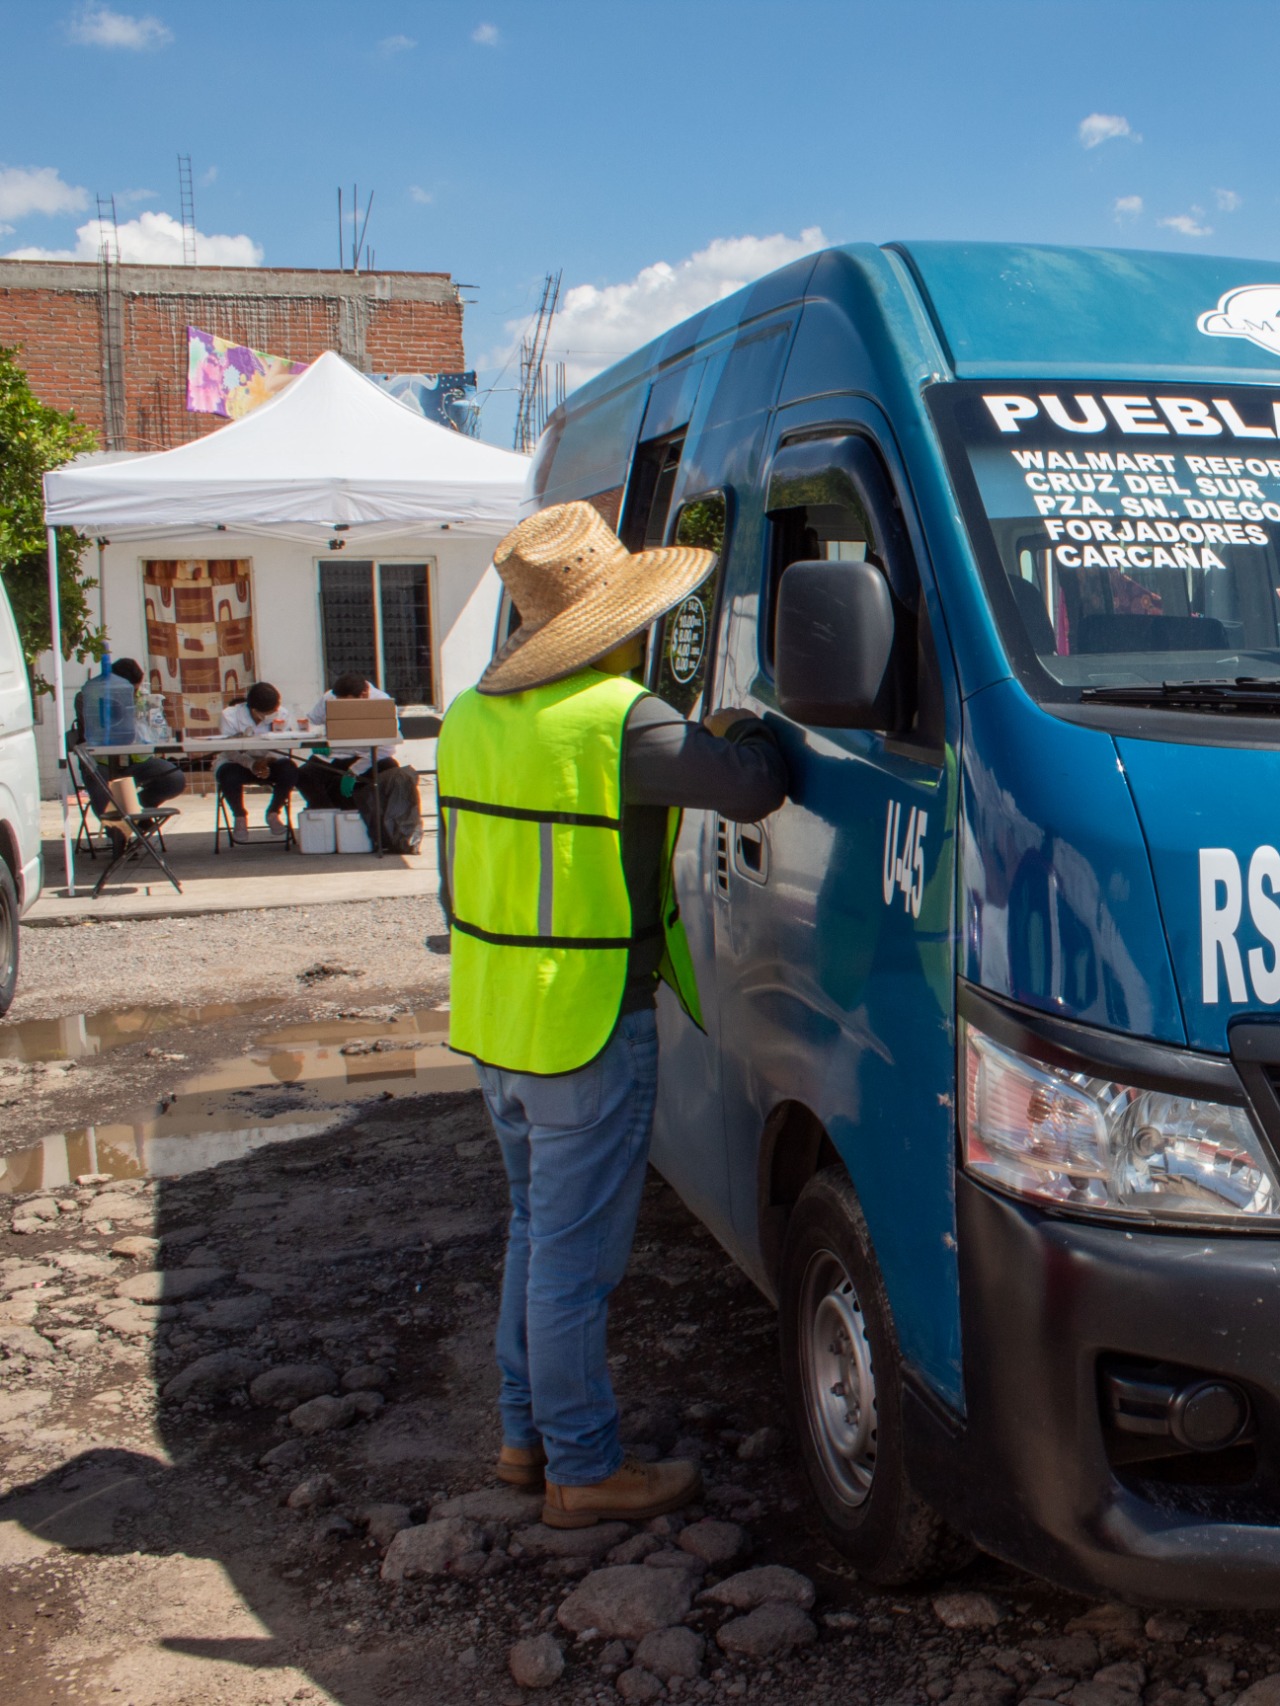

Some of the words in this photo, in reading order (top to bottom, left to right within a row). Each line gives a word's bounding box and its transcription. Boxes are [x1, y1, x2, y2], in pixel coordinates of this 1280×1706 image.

[1011, 451, 1175, 473] WALMART
[1025, 472, 1120, 494] CRUZ
[1124, 474, 1192, 497] DEL
[1196, 477, 1266, 499] SUR
[1033, 495, 1114, 516] PZA.
[1120, 497, 1180, 518] SN.
[1044, 519, 1269, 545] FORJADORES
[1056, 542, 1227, 569] CARCAÑA
[883, 799, 928, 919] U-45
